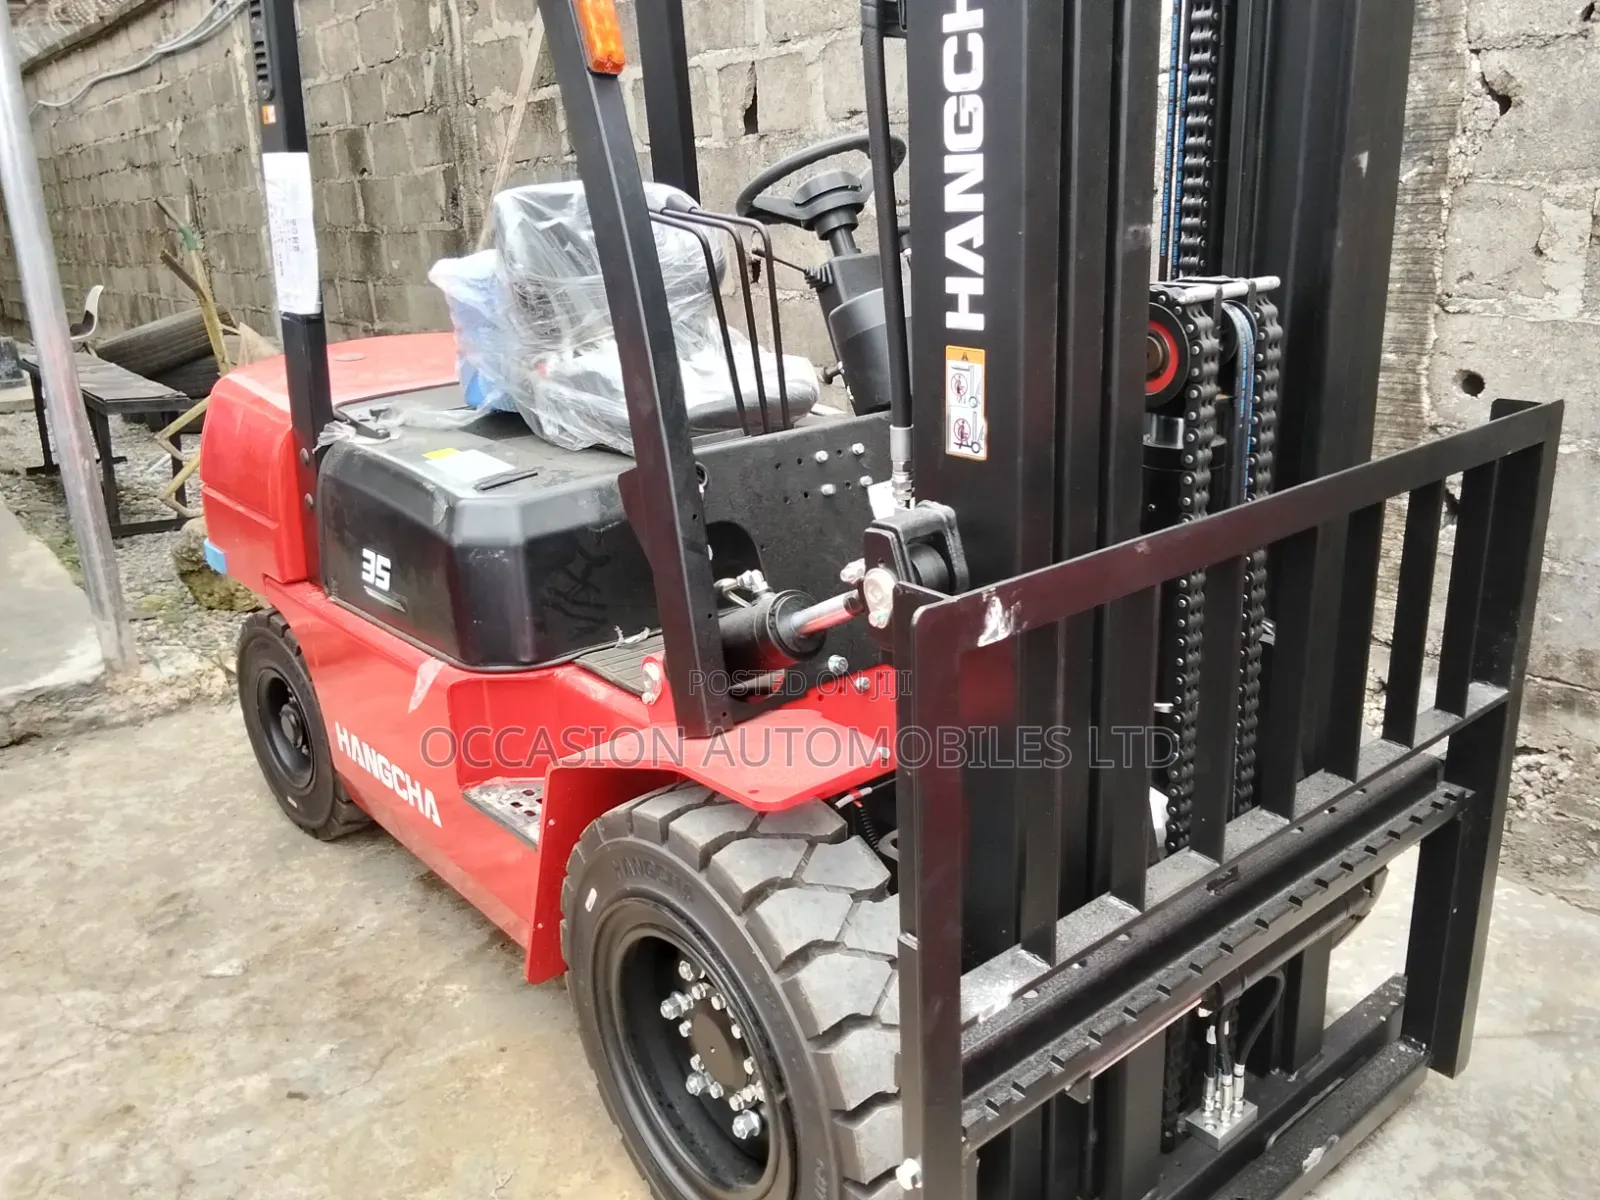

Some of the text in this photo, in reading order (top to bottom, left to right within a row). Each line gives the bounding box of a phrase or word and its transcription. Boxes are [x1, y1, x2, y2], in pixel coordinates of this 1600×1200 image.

[362, 548, 391, 592] 35
[335, 721, 442, 828] HANGCHA
[612, 856, 694, 903] HANGCHA
